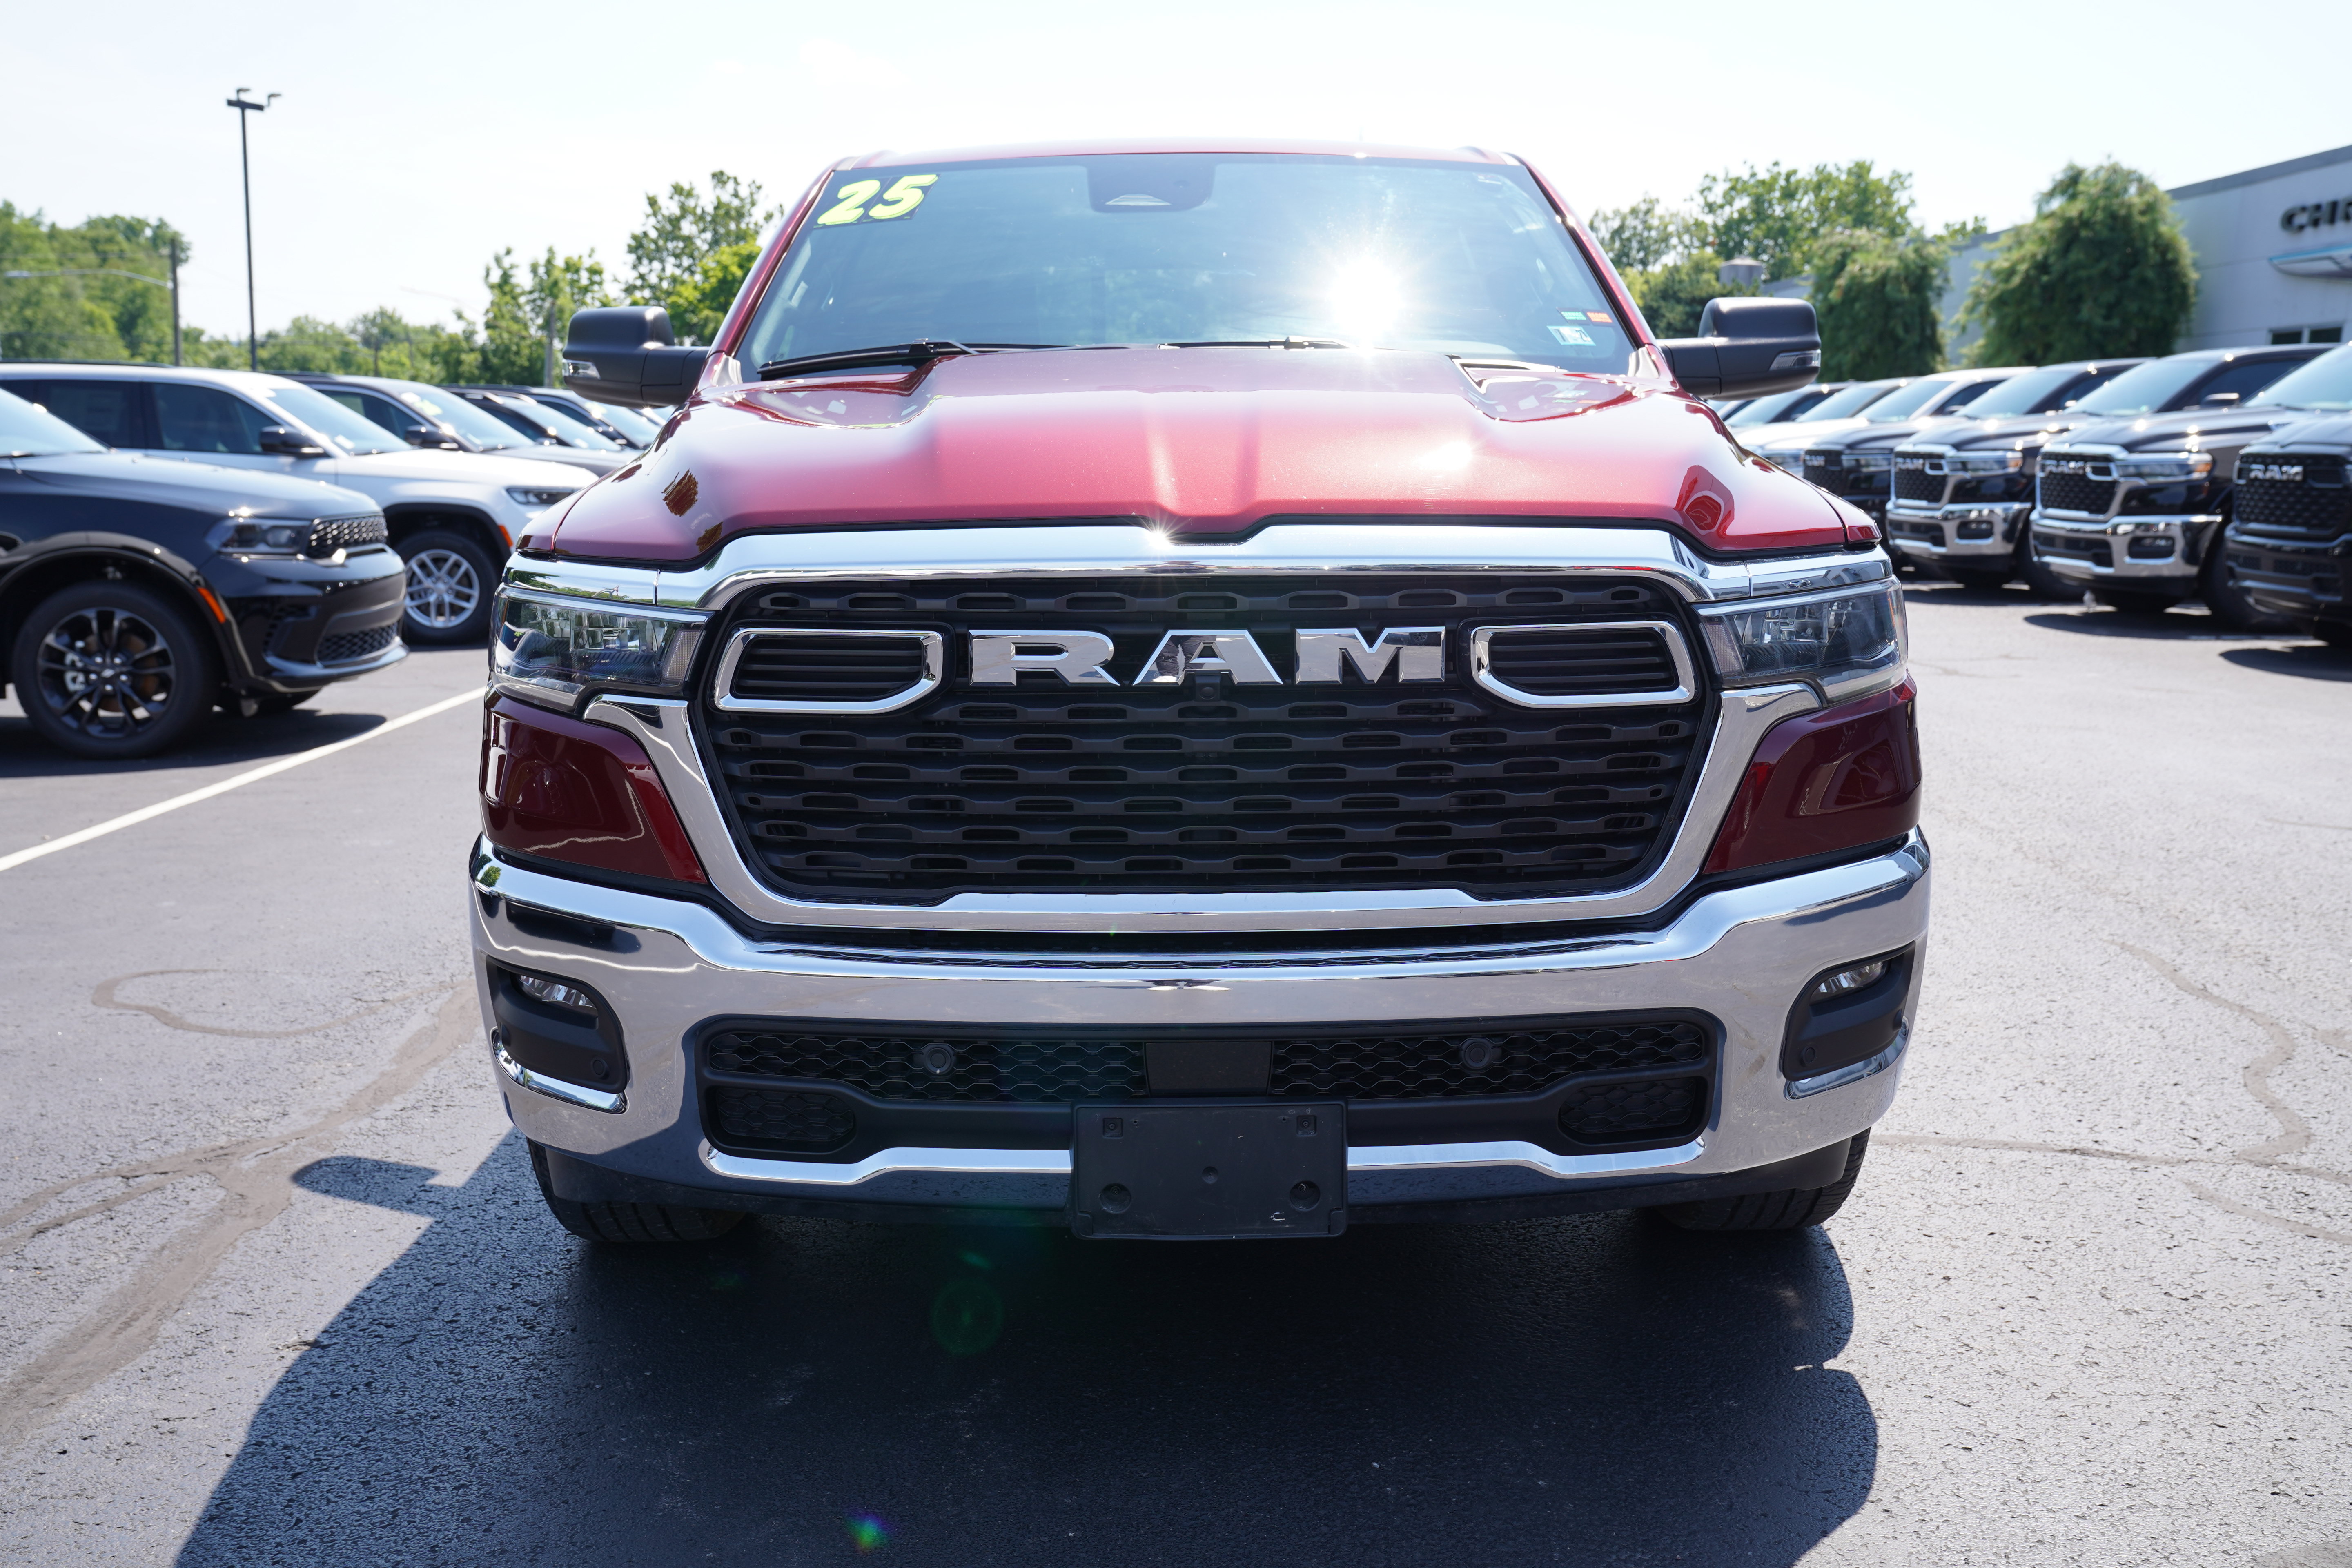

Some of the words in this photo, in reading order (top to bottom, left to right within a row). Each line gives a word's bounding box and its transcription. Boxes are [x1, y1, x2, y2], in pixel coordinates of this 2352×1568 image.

[817, 174, 938, 225] 25
[1895, 457, 1924, 472] RAM
[2044, 459, 2085, 476] RAM
[2249, 464, 2303, 481] RAM
[968, 626, 1446, 686] RAM
